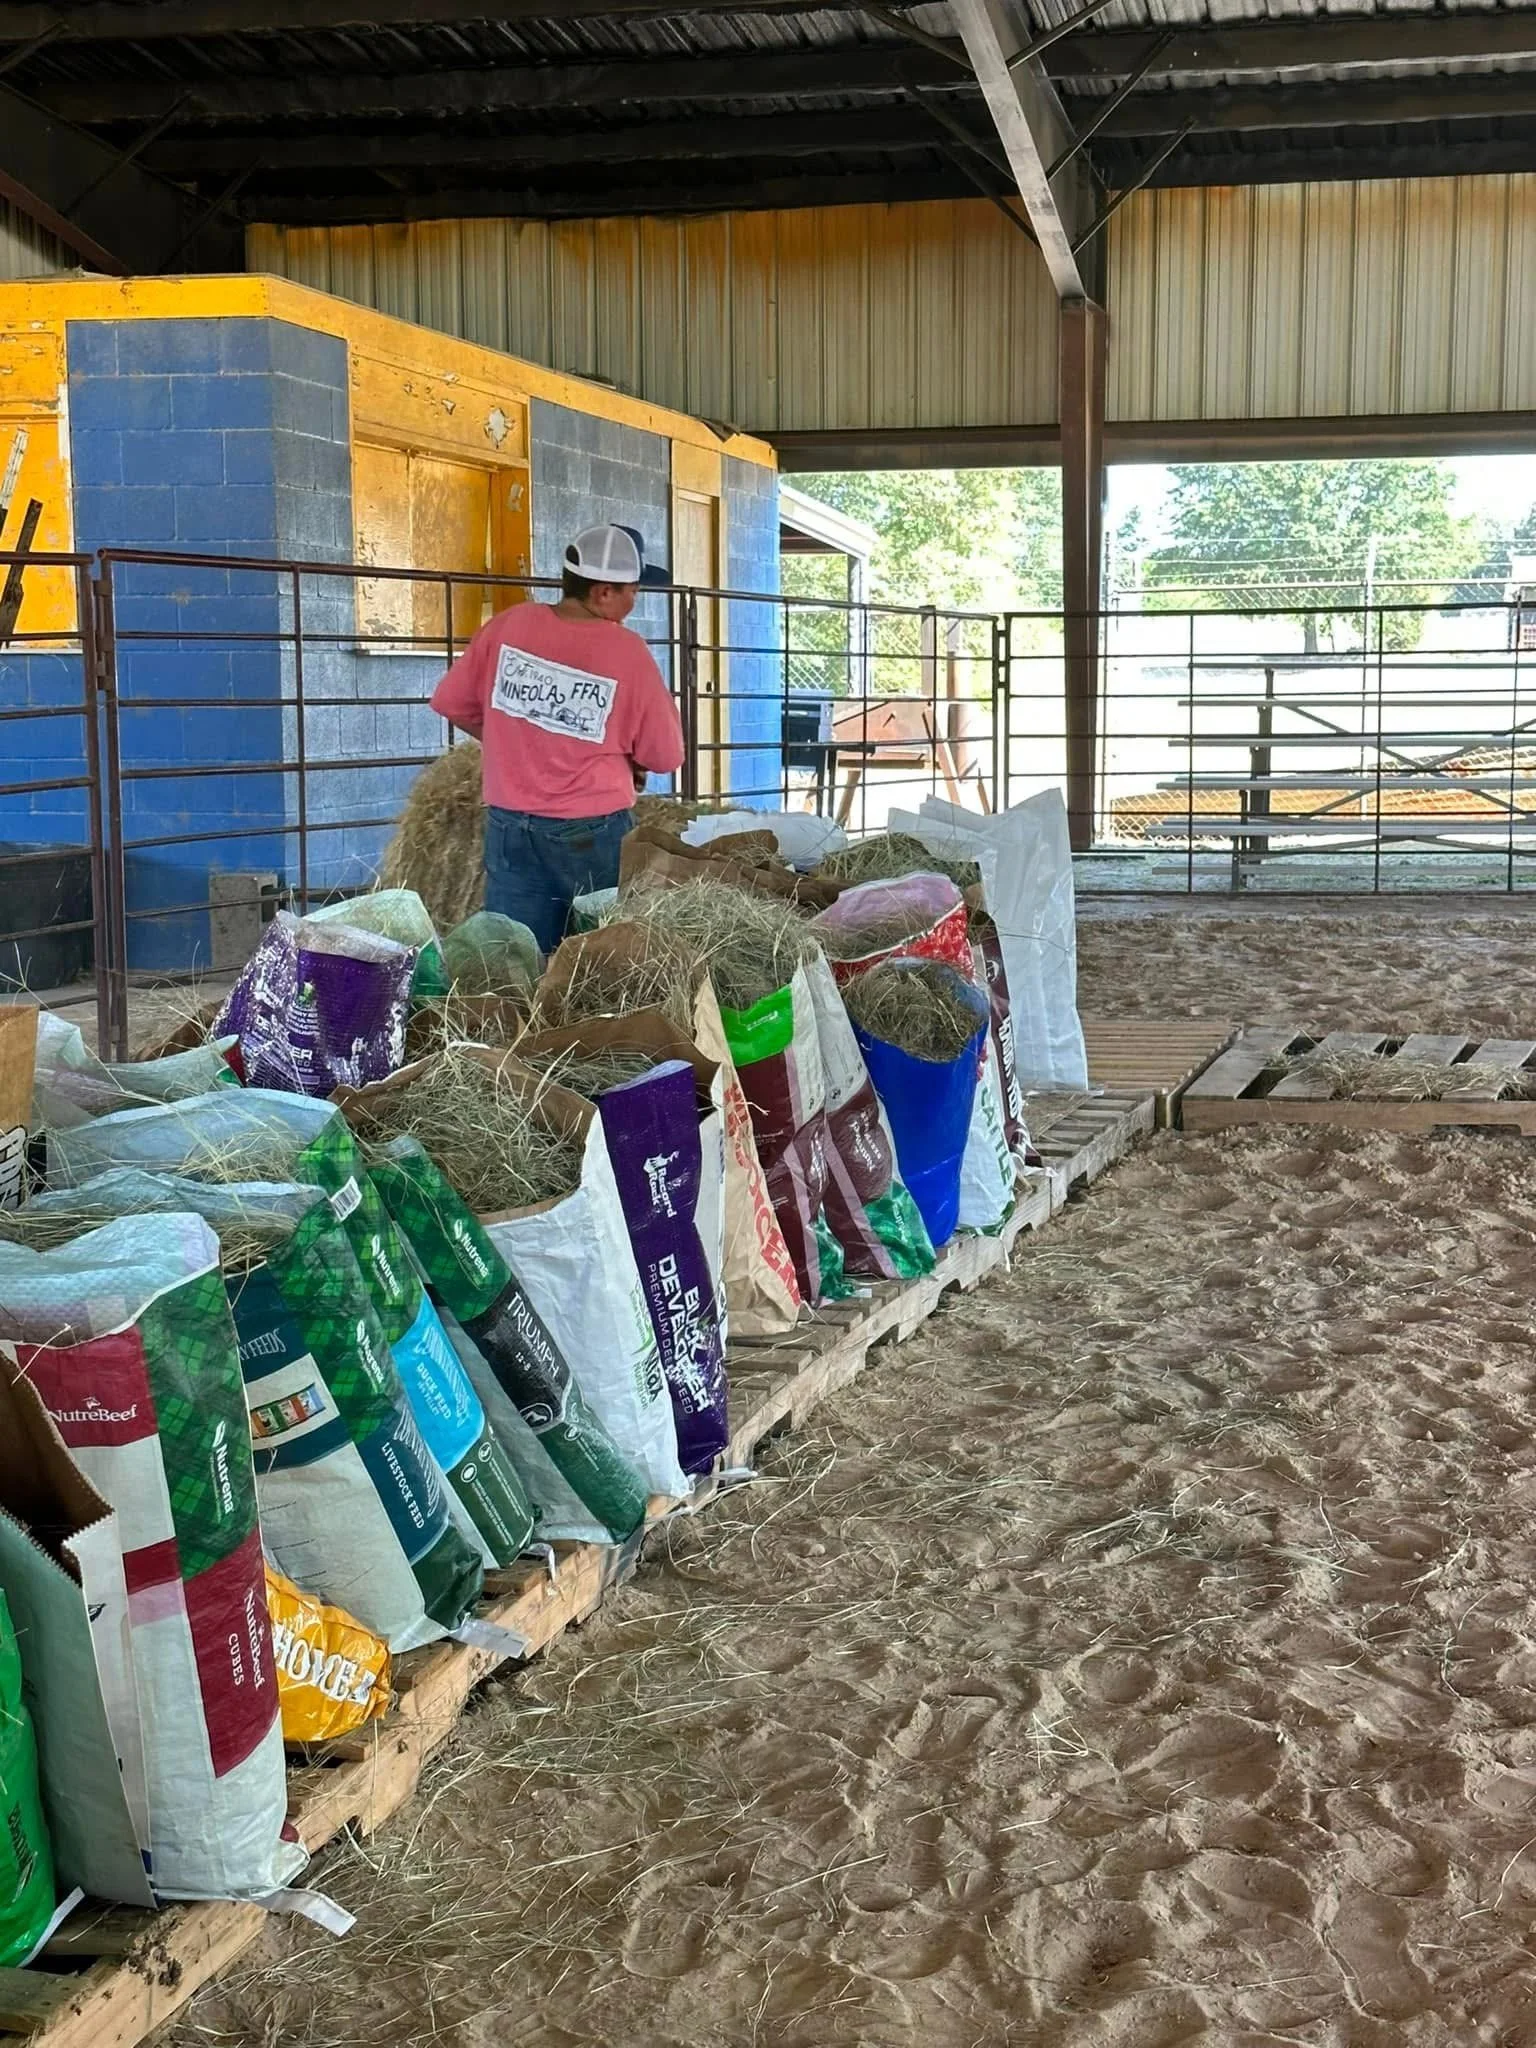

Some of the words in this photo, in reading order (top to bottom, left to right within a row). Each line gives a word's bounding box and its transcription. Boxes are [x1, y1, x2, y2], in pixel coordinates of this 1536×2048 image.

[501, 677, 566, 704] MINEOLA
[570, 682, 607, 708] FFA
[979, 1086, 1012, 1187] CATTLE
[648, 1171, 661, 1207] Rack
[660, 1166, 677, 1218] Record
[377, 1250, 401, 1297] Nutrena
[461, 1234, 489, 1279] Nutrena
[648, 1263, 670, 1338] PREMIUM
[248, 1327, 287, 1360] FEEDS
[506, 1291, 560, 1379] TRIUMPH
[658, 1253, 713, 1412] DEVELOPER
[361, 1337, 385, 1384] Nutrena
[49, 1404, 137, 1423] NutreBeef
[416, 1362, 437, 1393] DUCK
[432, 1390, 452, 1420] FEED
[214, 1443, 235, 1514] Nutrena
[381, 1441, 414, 1502] LIVESTOCK
[407, 1500, 426, 1530] FEED
[227, 1632, 244, 1687] CUBES
[244, 1589, 266, 1690] NutreBeef
